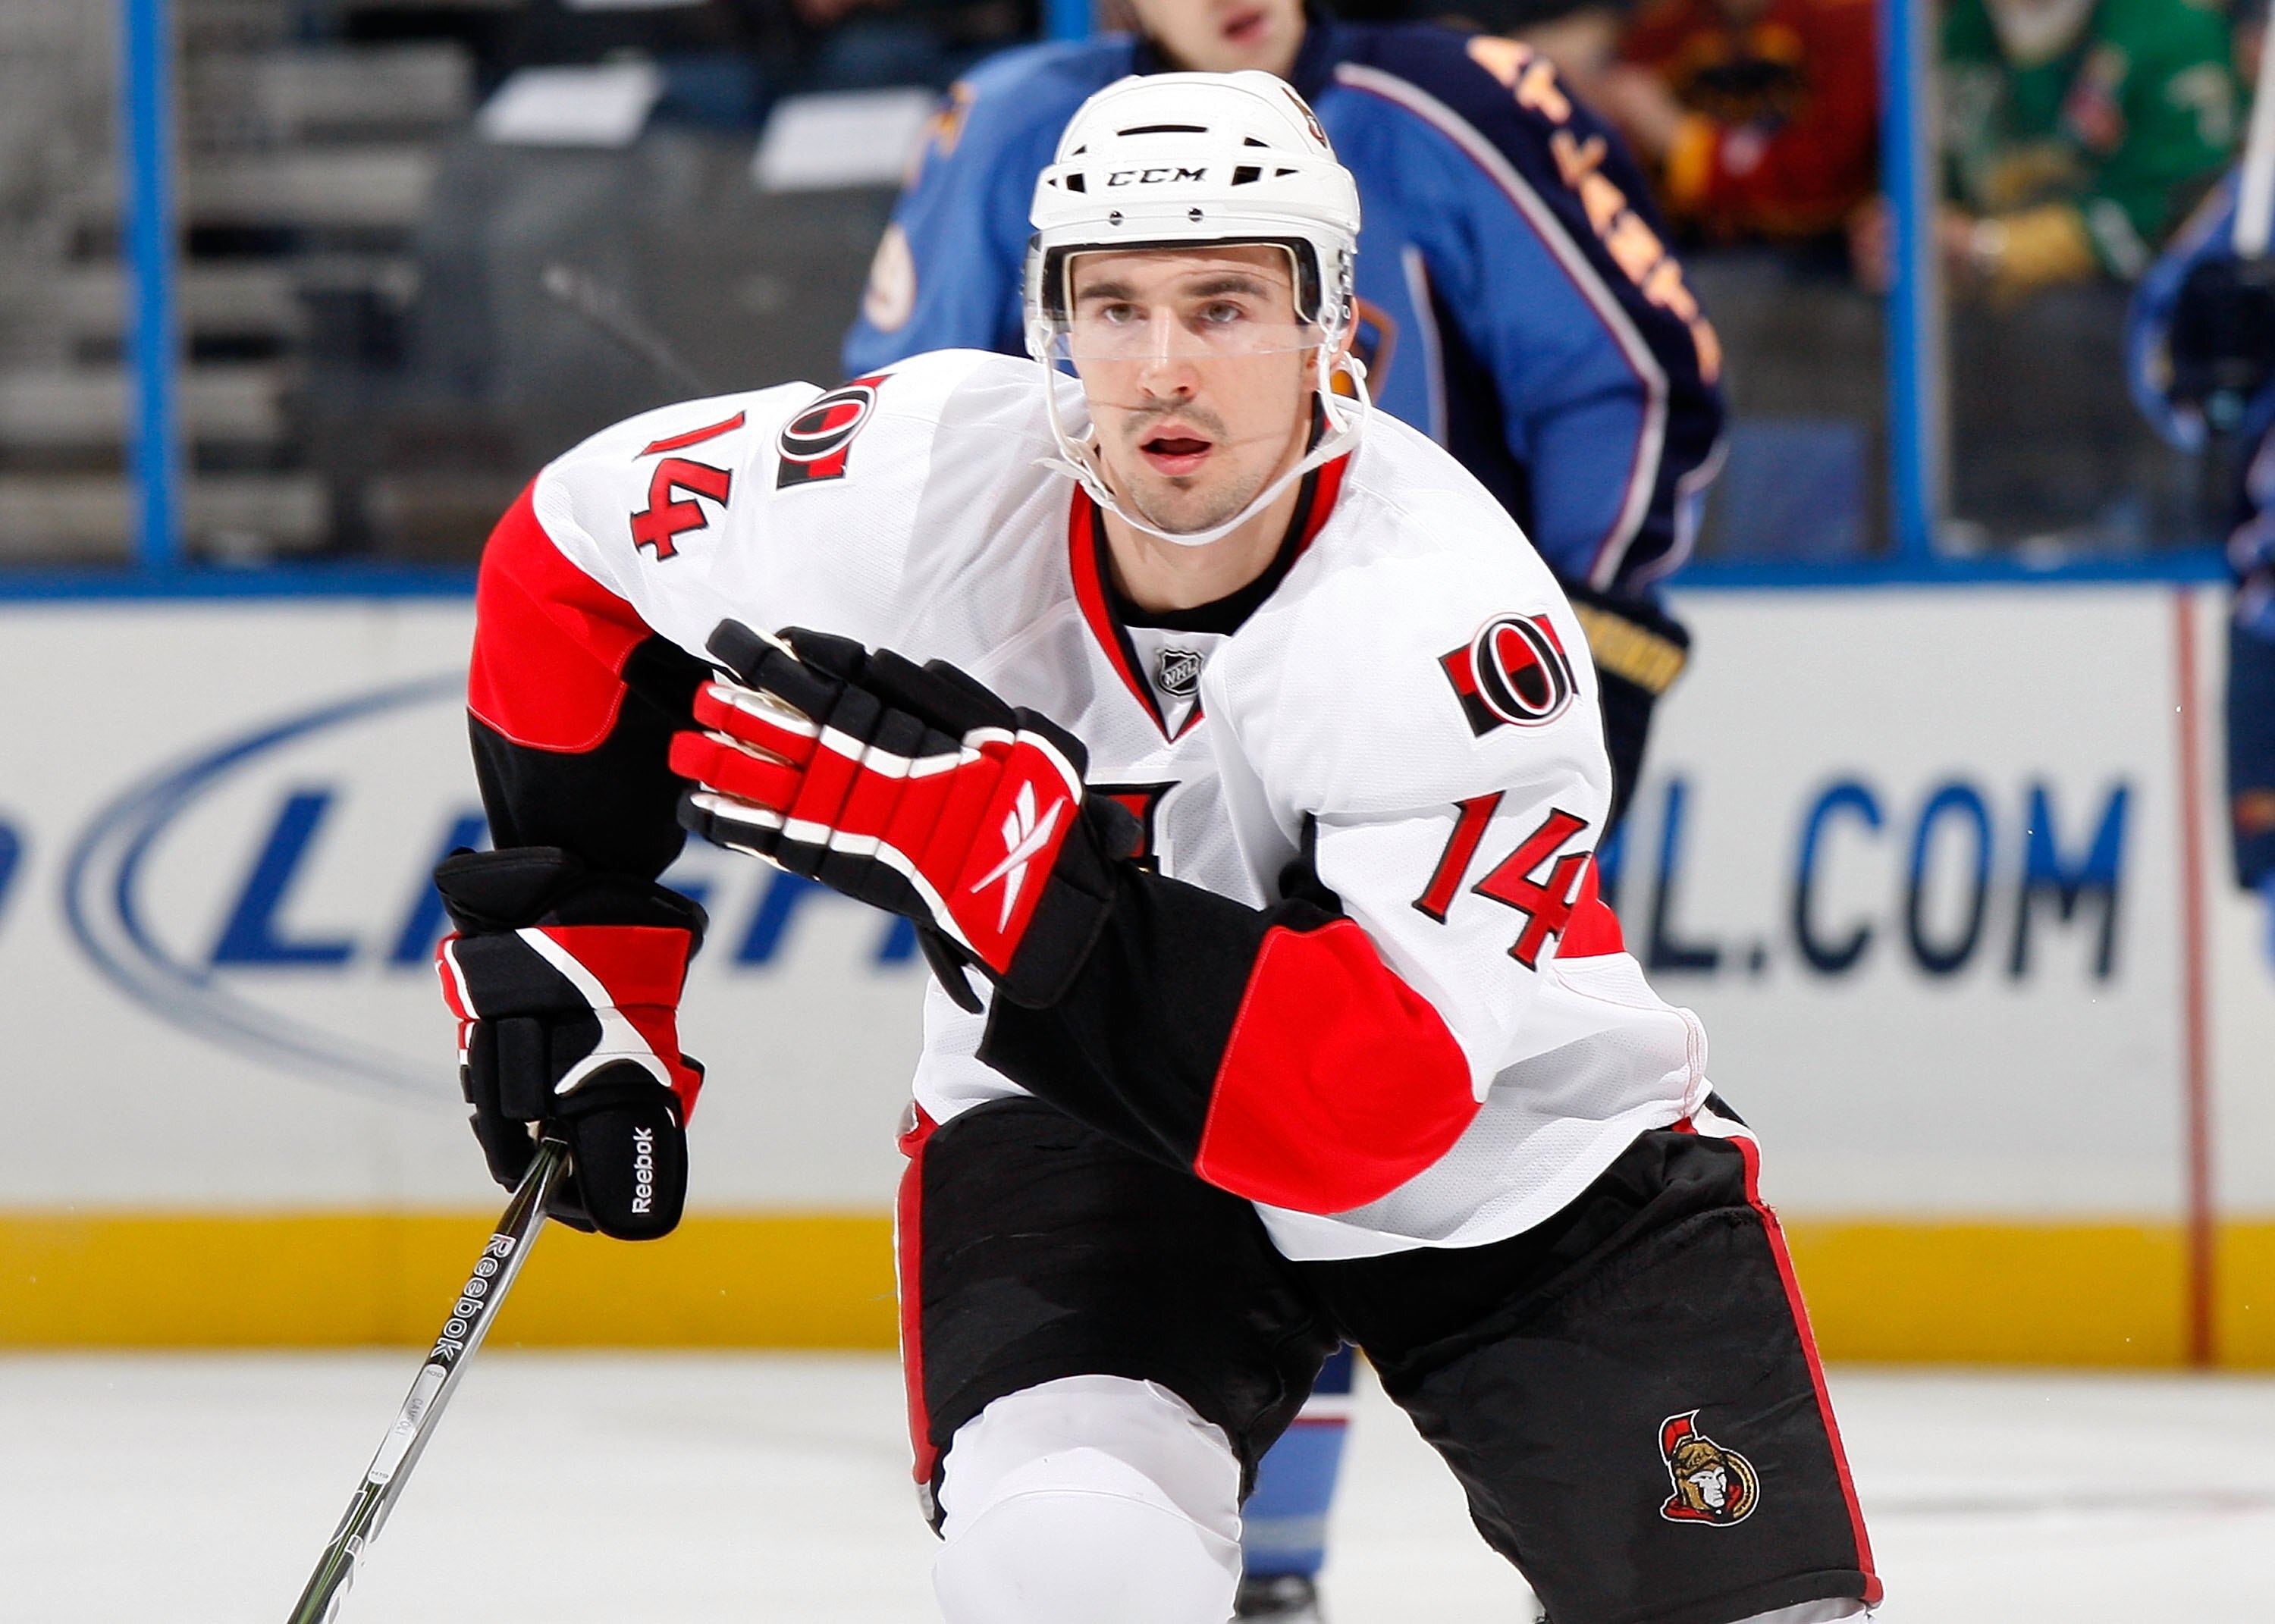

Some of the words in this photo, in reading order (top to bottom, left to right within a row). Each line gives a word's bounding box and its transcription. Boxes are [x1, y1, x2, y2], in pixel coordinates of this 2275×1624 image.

[1106, 167, 1209, 187] CCM
[631, 409, 747, 563] 14
[1162, 657, 1199, 686] NHL
[1410, 788, 1595, 973] 14
[632, 1126, 654, 1214] Reebok
[430, 1233, 517, 1362] Reebok
